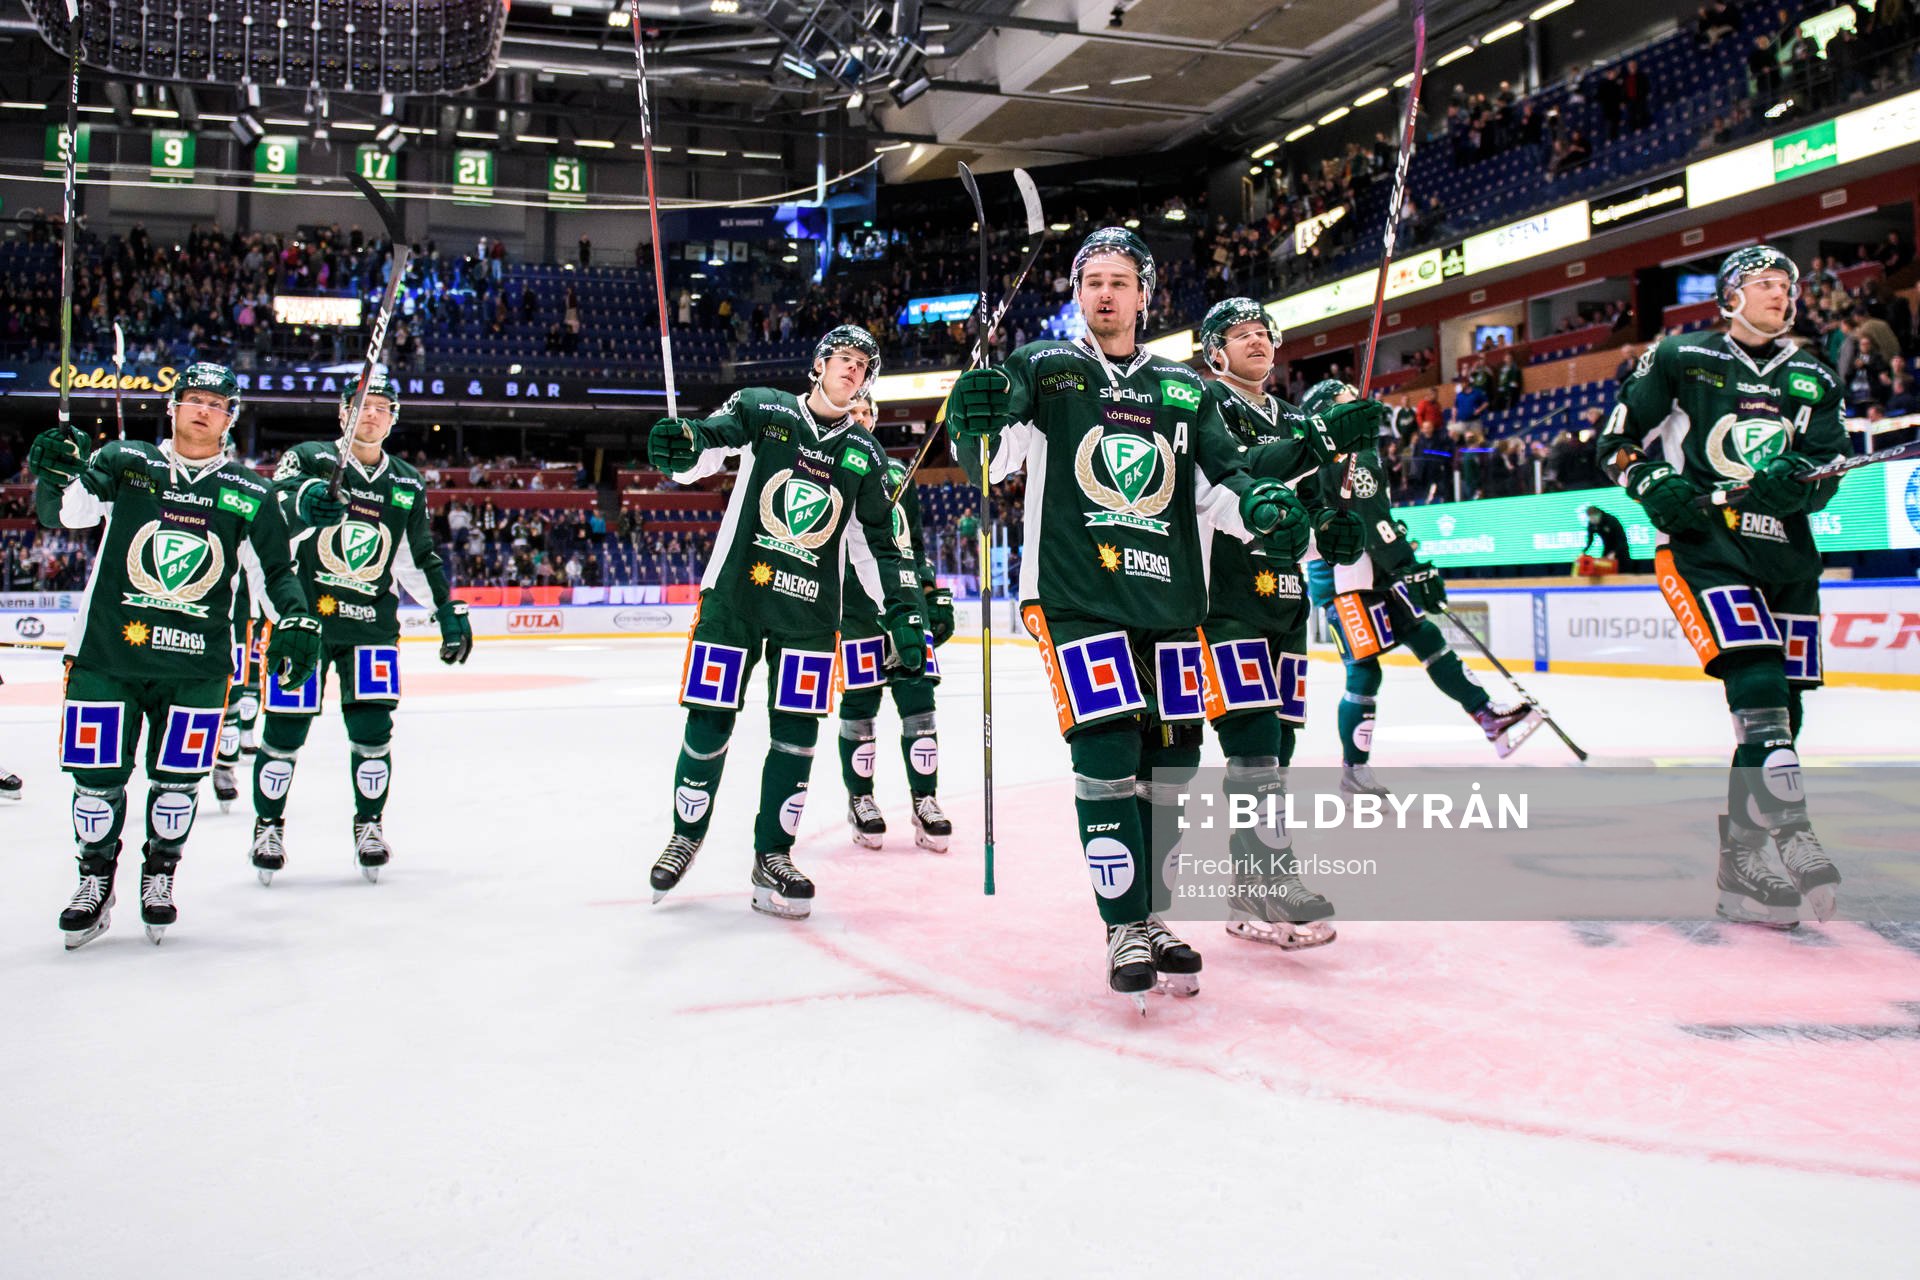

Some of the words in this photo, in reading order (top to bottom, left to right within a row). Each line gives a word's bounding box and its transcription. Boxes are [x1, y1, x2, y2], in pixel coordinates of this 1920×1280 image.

[71, 75, 80, 104] CCM
[1409, 96, 1419, 126] CCM
[164, 138, 183, 166] 9
[267, 145, 285, 172] 9
[361, 152, 390, 179] 17
[458, 158, 487, 185] 21
[553, 164, 581, 191] 51
[366, 306, 391, 364] CCM
[237, 373, 445, 395] RESTAANG
[467, 379, 483, 396] &
[506, 382, 560, 398] BAR
[1100, 387, 1153, 404] stadium
[1106, 410, 1151, 425] LÖFBERGS
[1794, 405, 1813, 434] A
[1172, 422, 1188, 454] A
[1745, 427, 1762, 449] F
[1117, 442, 1135, 470] F
[1808, 446, 1906, 477] JETSPEED
[1124, 461, 1144, 489] BK
[162, 490, 213, 508] stadium
[792, 487, 812, 507] F
[794, 504, 816, 525] BK
[1107, 513, 1155, 527] KARLSTAD
[162, 538, 184, 560] F
[350, 528, 365, 549] F
[167, 554, 191, 579] BK
[1124, 547, 1171, 577] ENERGI
[773, 569, 819, 599] ENERGI
[1404, 568, 1439, 584] CCM
[279, 615, 323, 634] CC
[510, 613, 560, 629] JULA
[1662, 575, 1712, 654] armat
[152, 625, 206, 650] ENERGI
[1568, 617, 1688, 640] UNISPOR
[1086, 822, 1121, 833] CCM
